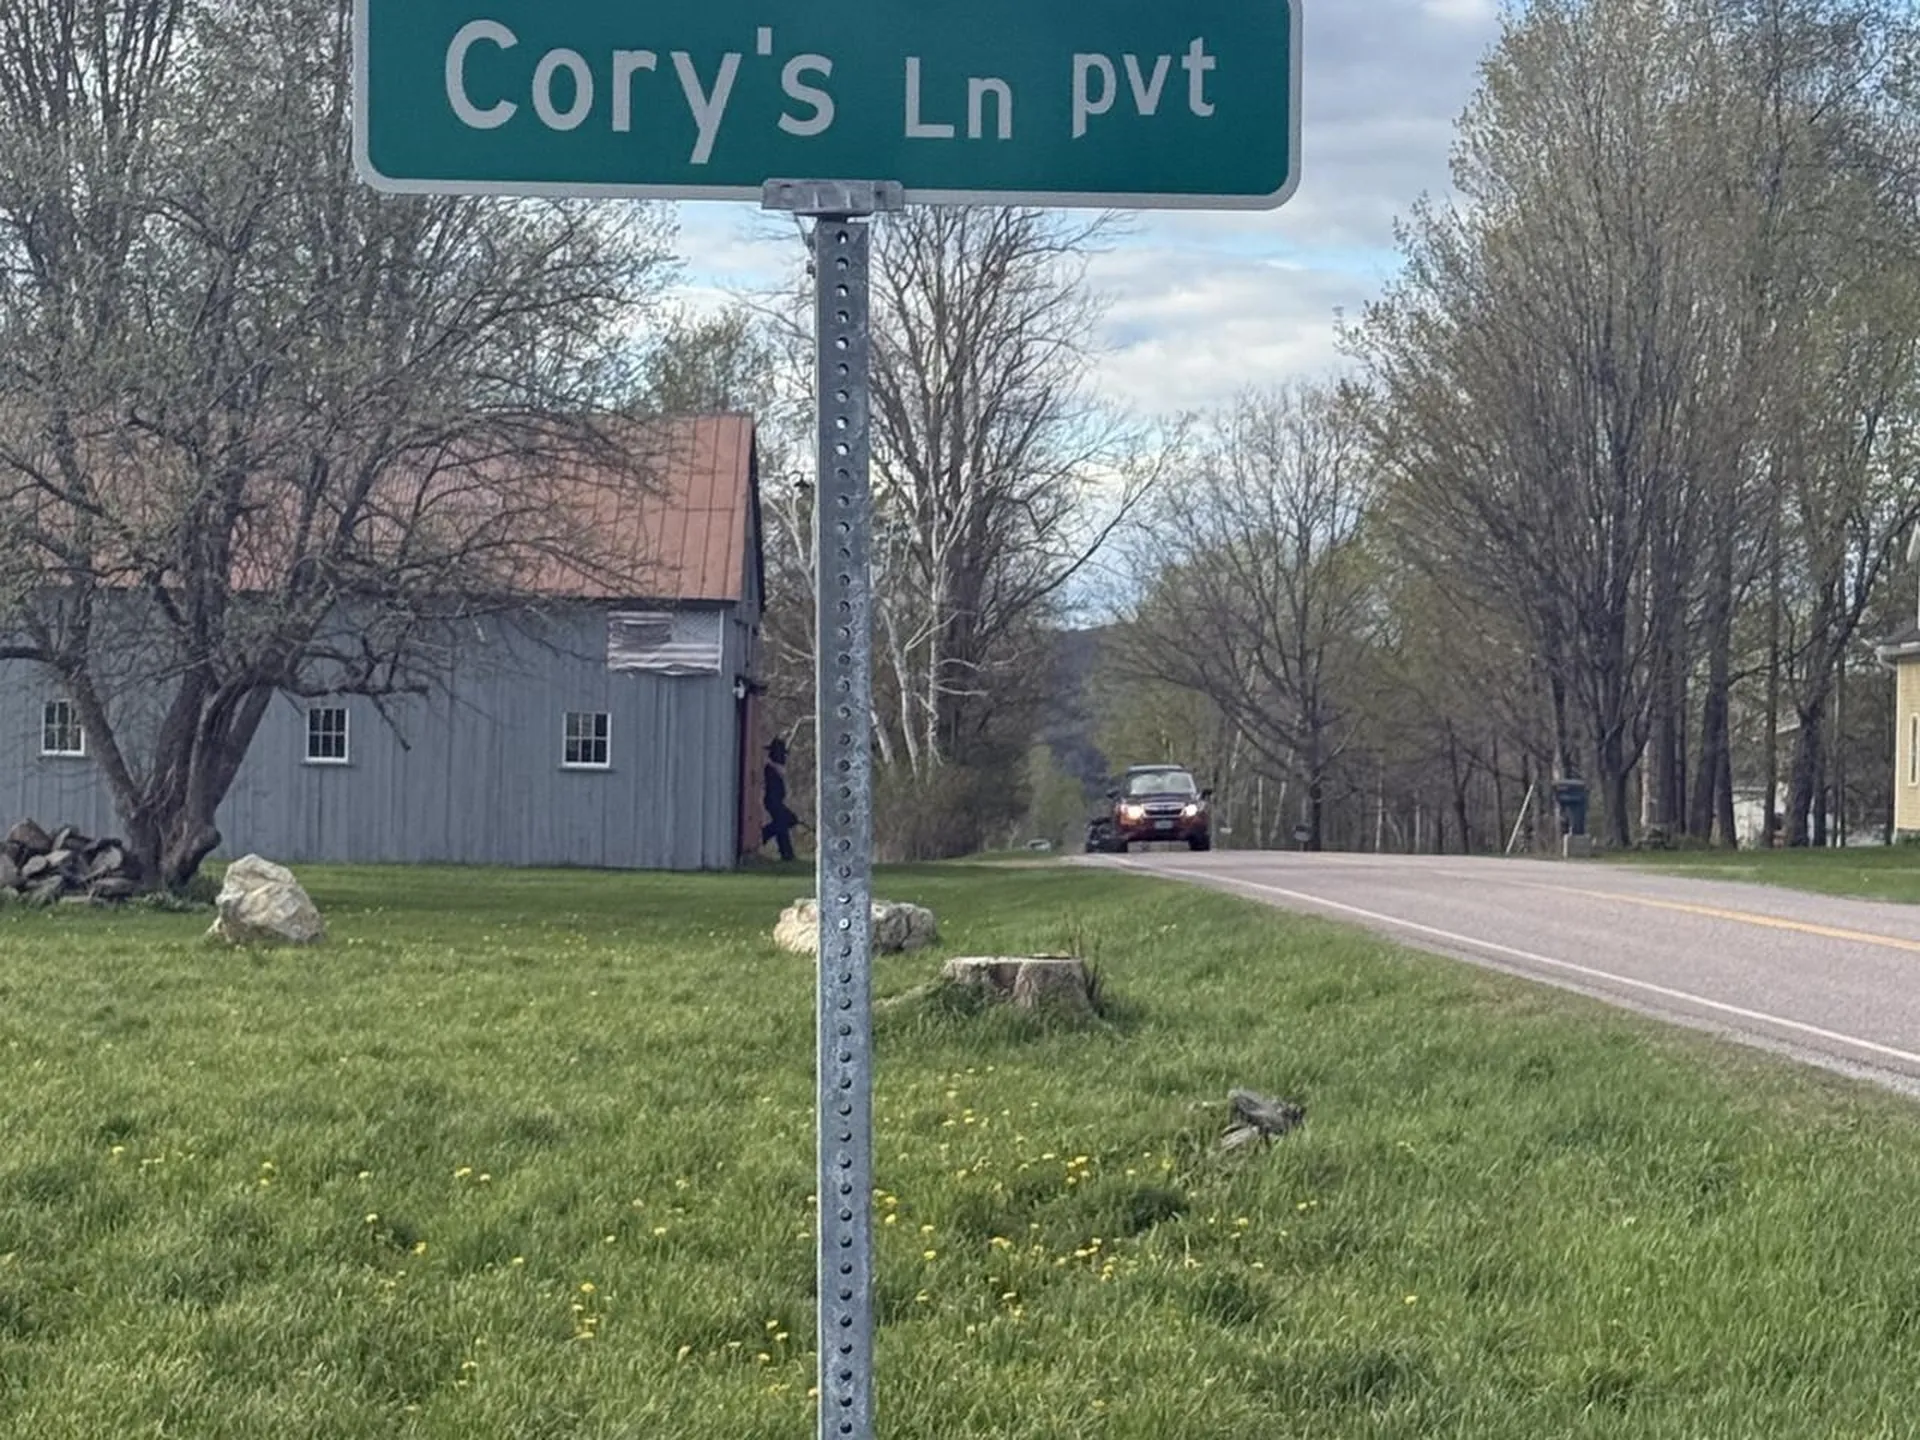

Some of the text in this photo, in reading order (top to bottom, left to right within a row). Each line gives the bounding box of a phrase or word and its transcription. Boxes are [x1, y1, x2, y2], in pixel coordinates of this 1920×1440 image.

[445, 19, 1216, 164] Cory's Ln pvt
